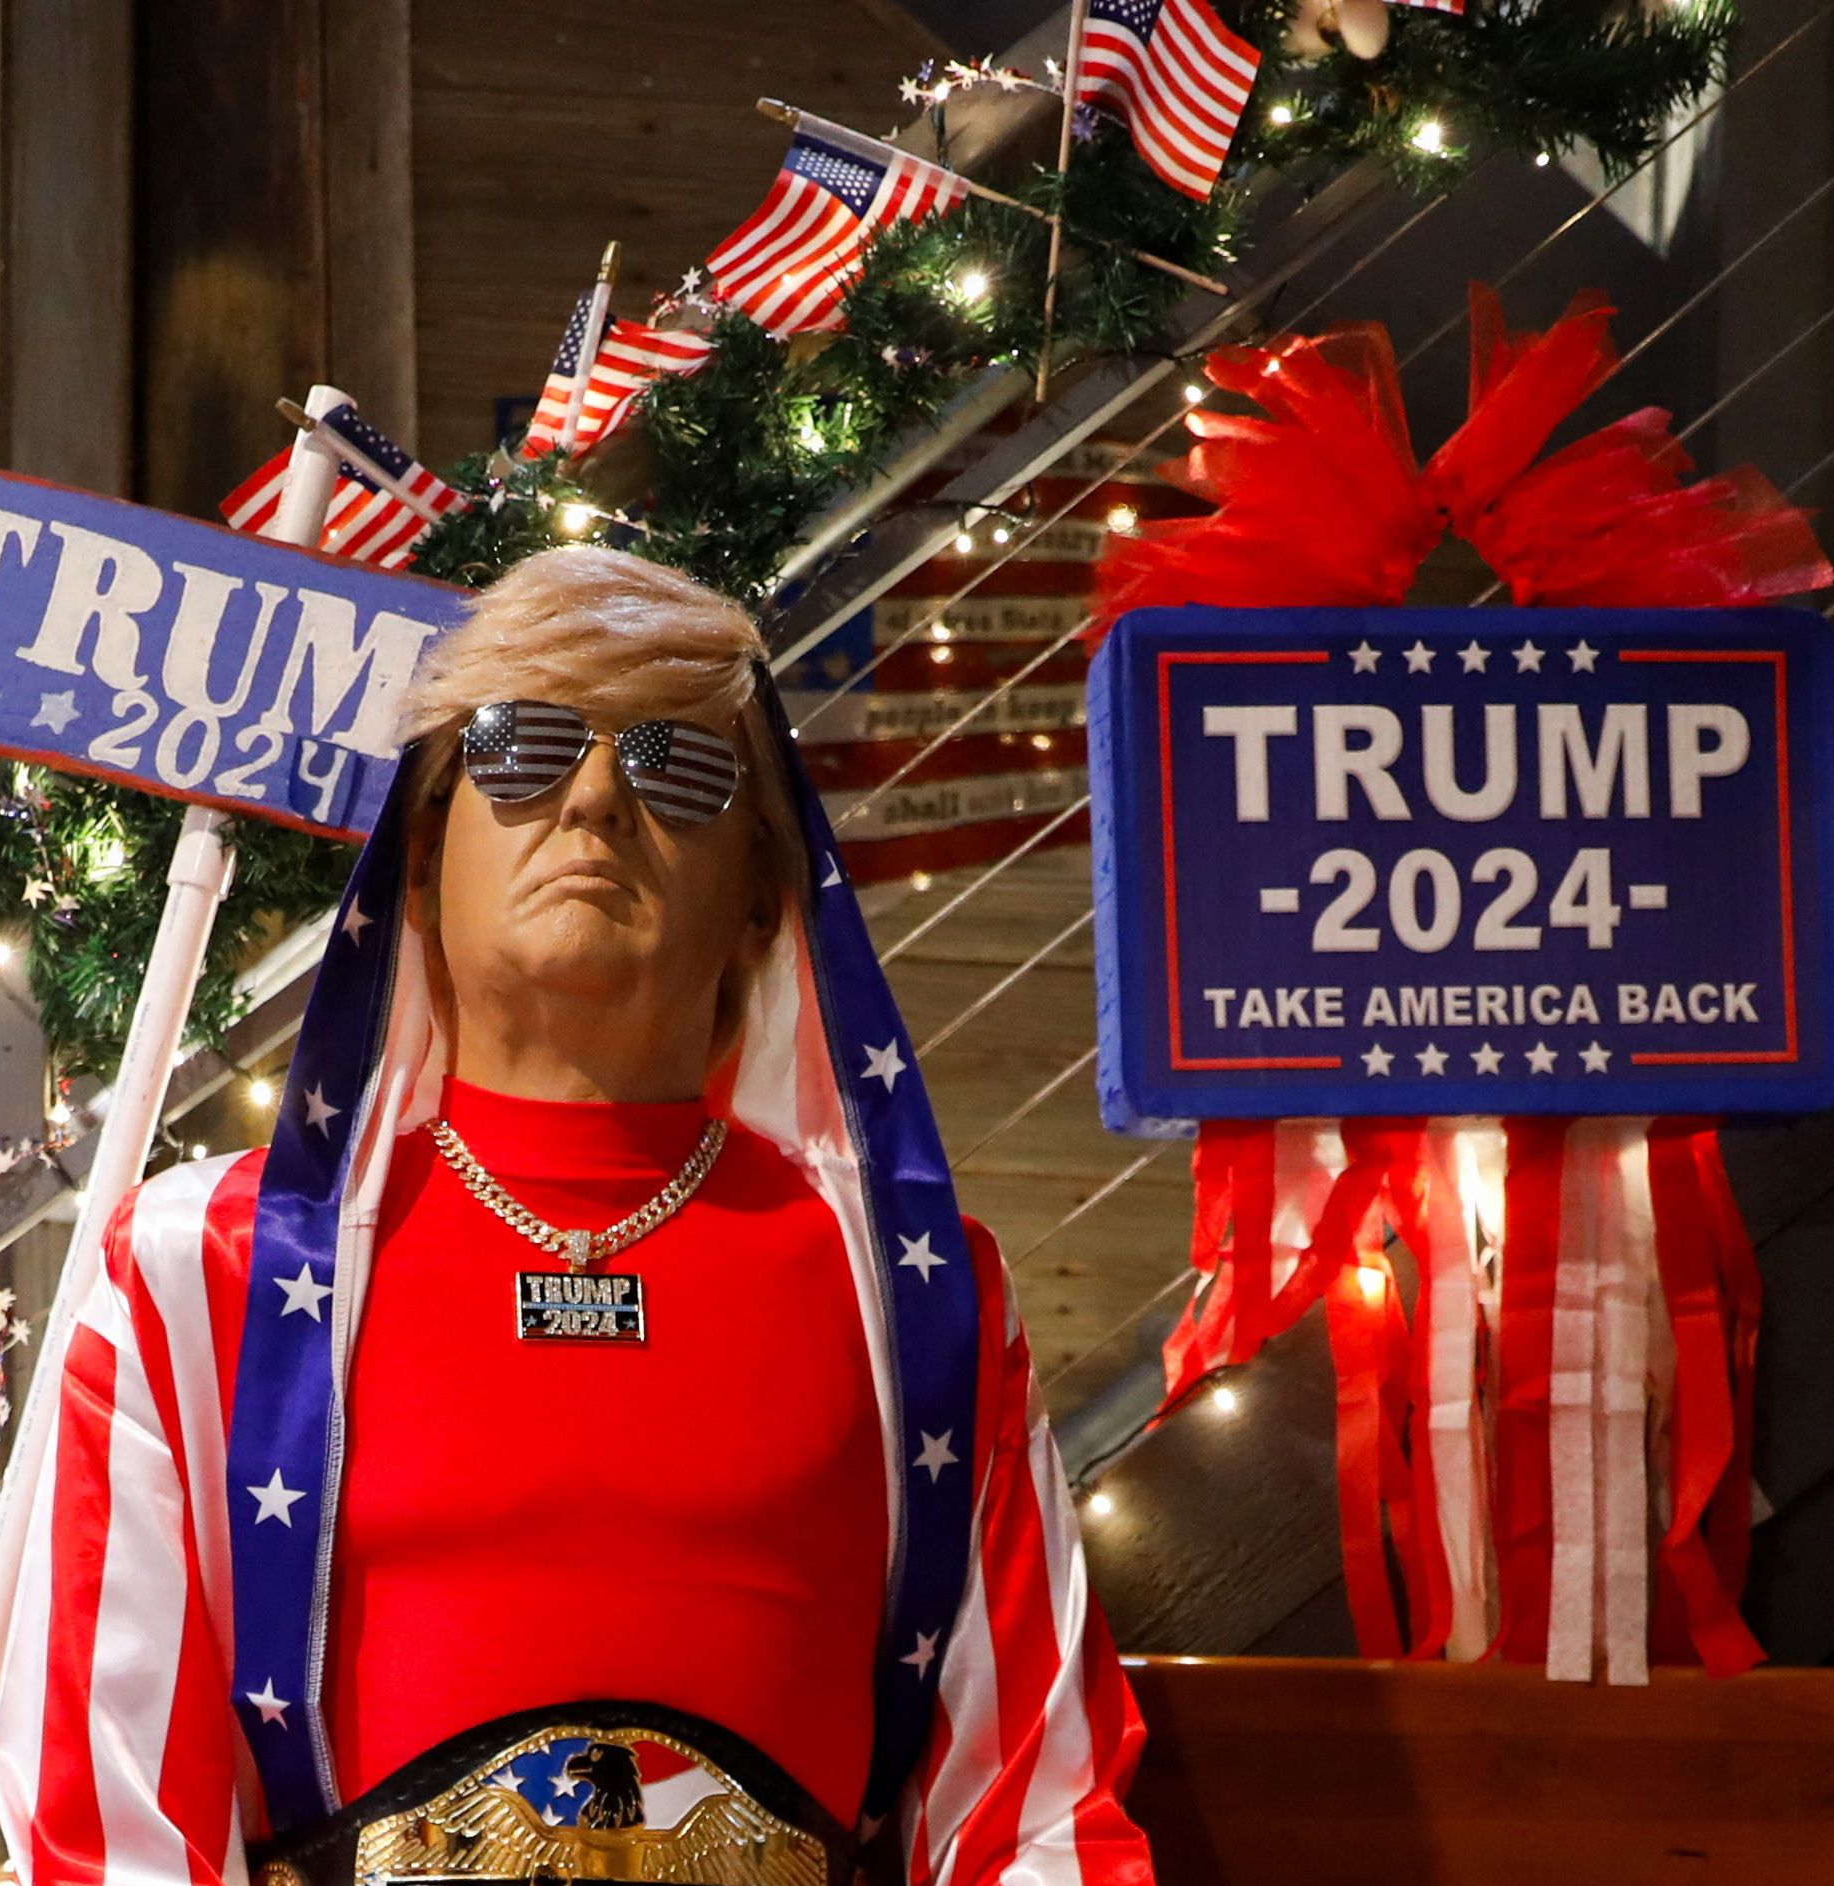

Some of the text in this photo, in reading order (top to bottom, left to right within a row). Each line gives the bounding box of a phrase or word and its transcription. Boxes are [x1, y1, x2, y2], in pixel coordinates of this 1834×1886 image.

[86, 689, 349, 824] 2024
[1202, 703, 1752, 823] TRUMP
[1203, 981, 1760, 1030] TAKE AMERICA BACK
[525, 1275, 631, 1306] TRUMP
[541, 1309, 620, 1338] 2024
